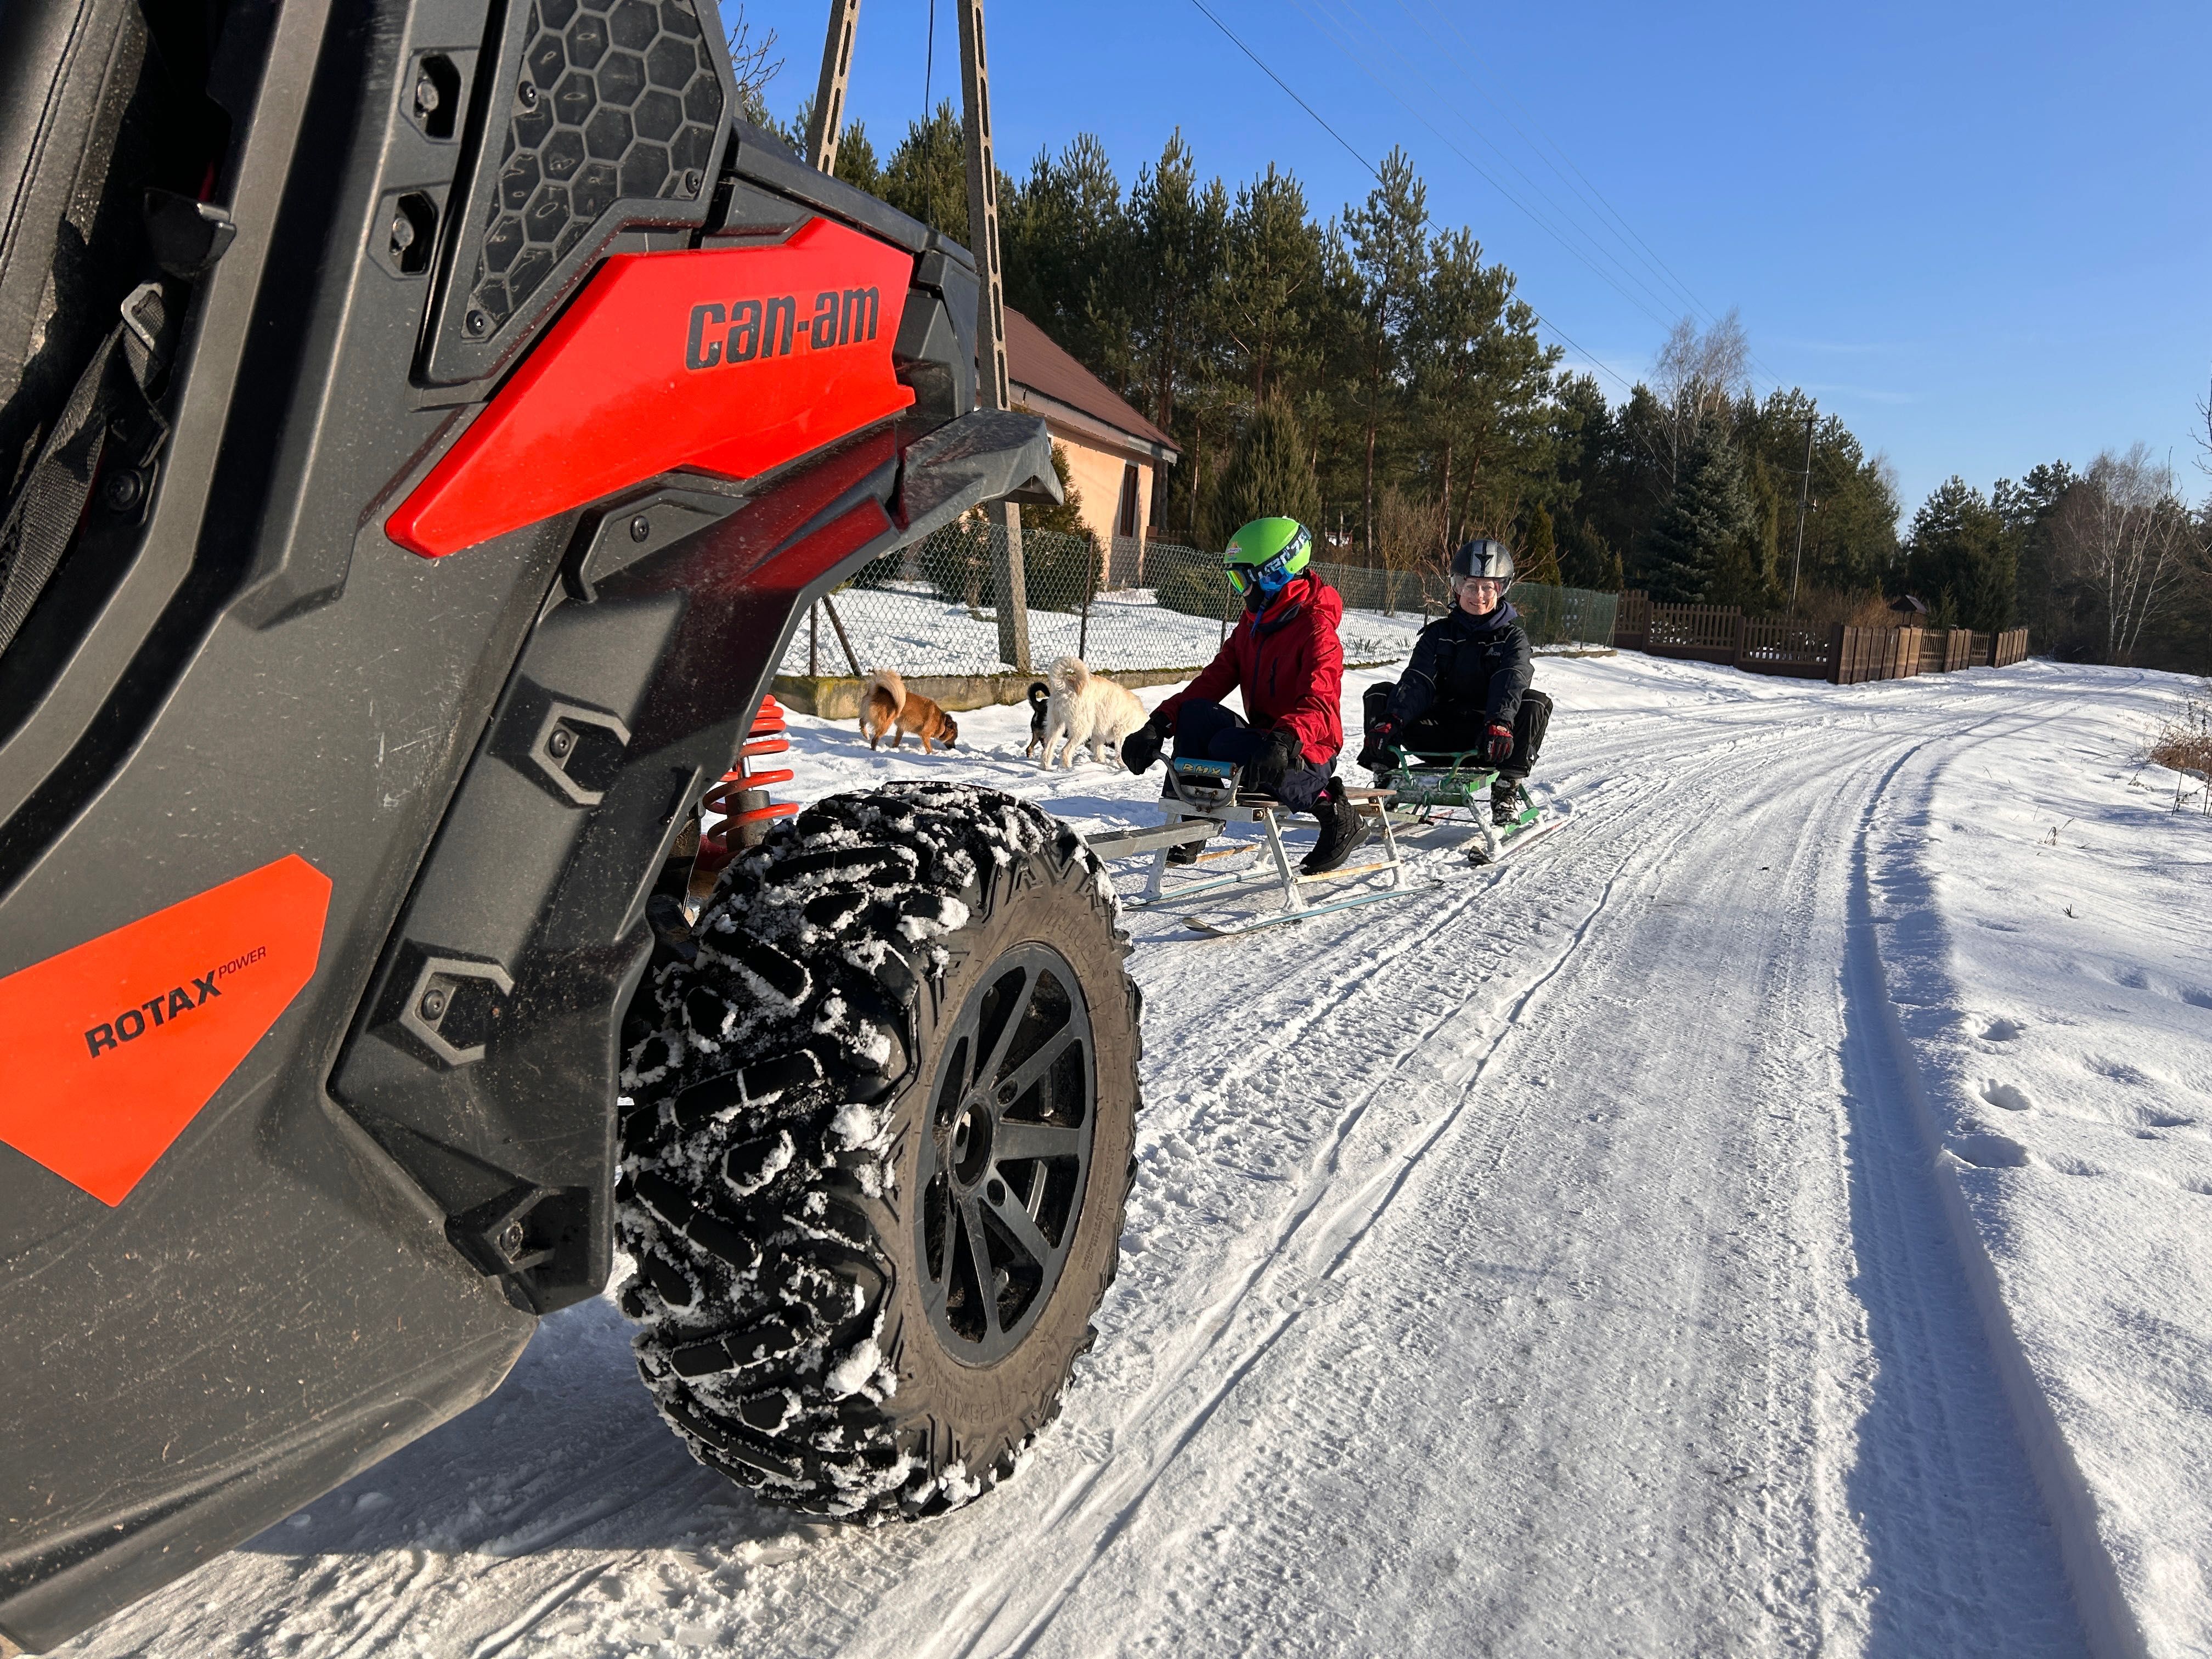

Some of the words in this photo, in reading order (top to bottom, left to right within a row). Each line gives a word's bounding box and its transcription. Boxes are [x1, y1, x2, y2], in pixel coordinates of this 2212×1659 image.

[685, 286, 879, 371] can-am
[1182, 763, 1221, 776] BMX
[84, 969, 222, 1059] ROTAX
[218, 946, 267, 979] POWER
